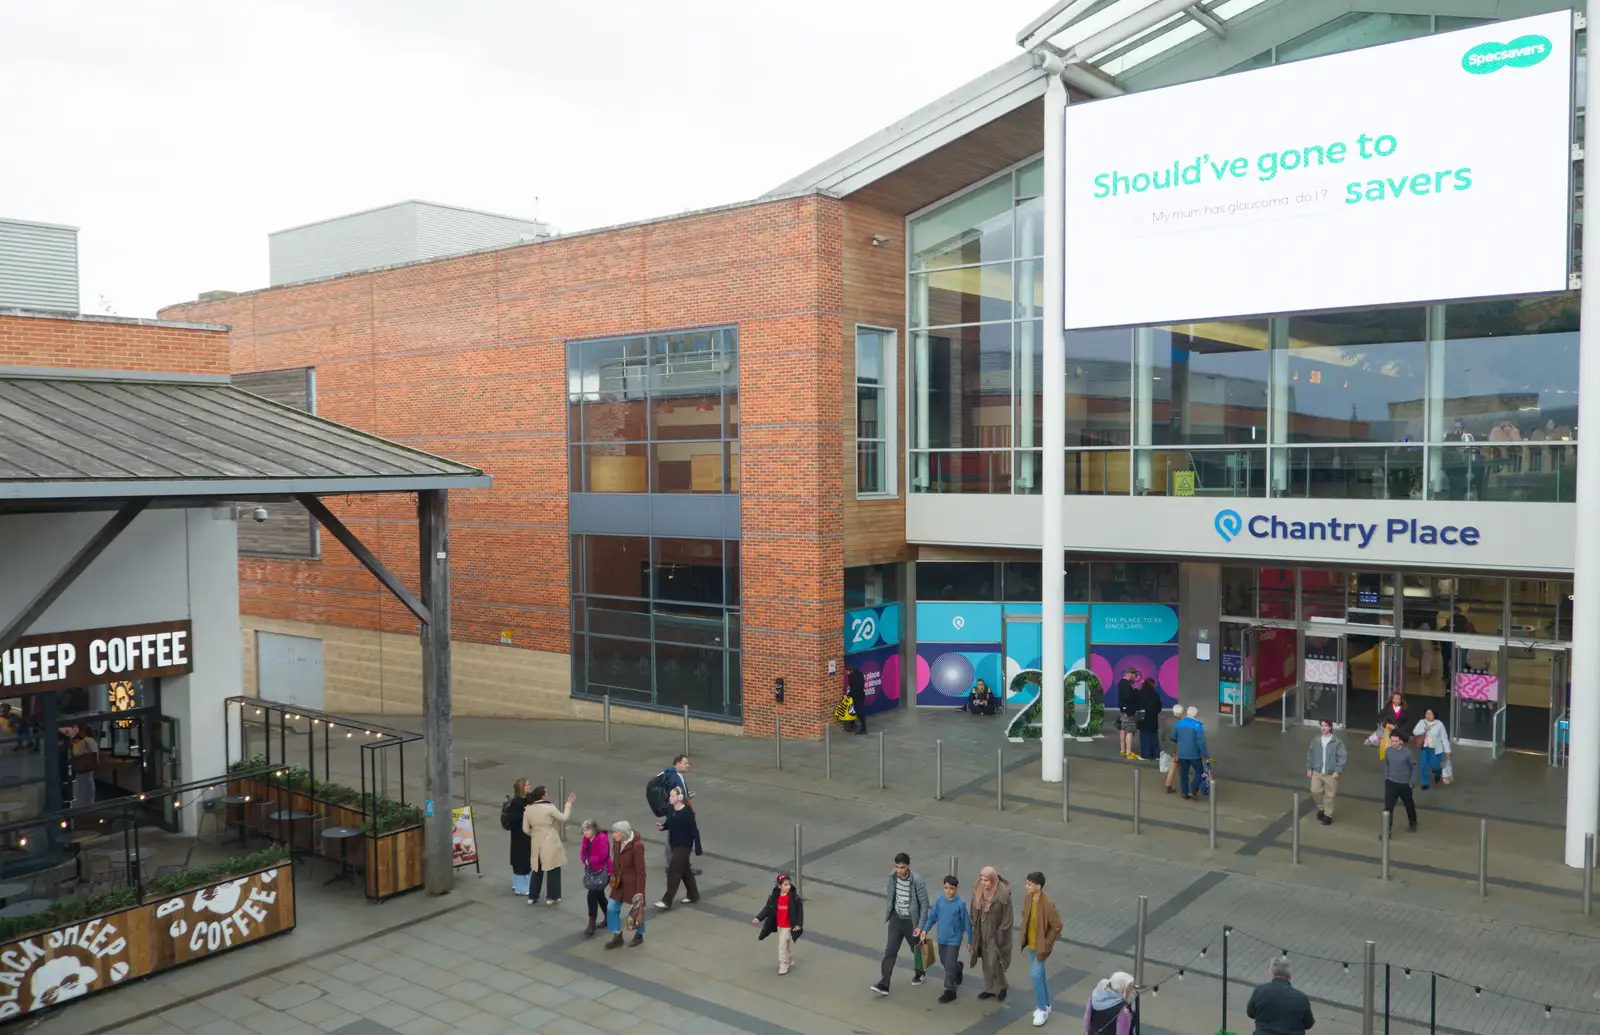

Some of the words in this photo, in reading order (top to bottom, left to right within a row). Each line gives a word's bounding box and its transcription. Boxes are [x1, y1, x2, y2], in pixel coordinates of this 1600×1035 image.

[1468, 43, 1545, 66] Specsavers
[1093, 154, 1249, 199] Should've
[1257, 141, 1347, 182] gone
[1356, 133, 1398, 160] to
[1345, 166, 1474, 205] savers
[1152, 211, 1169, 223] My
[1172, 208, 1201, 220] mum
[1204, 204, 1225, 216] has
[1295, 191, 1312, 204] do
[1248, 515, 1378, 549] Chantry
[1386, 518, 1481, 546] Place
[852, 617, 875, 642] 20
[89, 631, 188, 675] COFFEE
[189, 887, 277, 951] COFFEE
